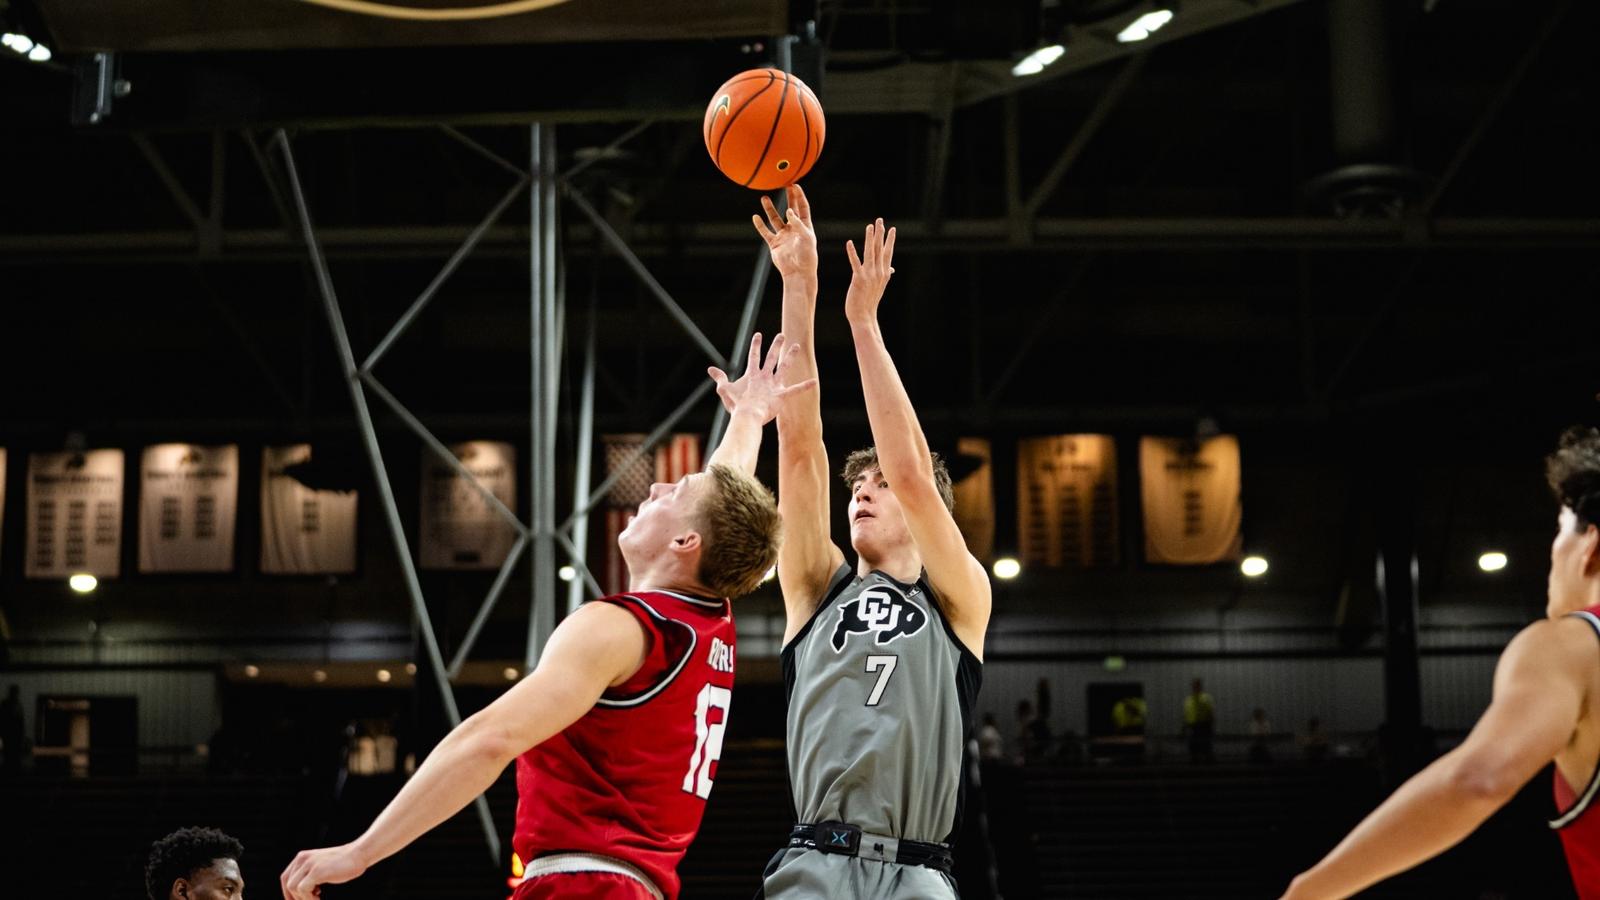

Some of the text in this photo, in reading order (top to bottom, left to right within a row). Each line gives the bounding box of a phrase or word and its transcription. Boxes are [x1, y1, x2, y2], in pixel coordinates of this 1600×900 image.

[857, 590, 902, 631] CU
[864, 654, 898, 707] 7
[681, 682, 732, 801] 12
